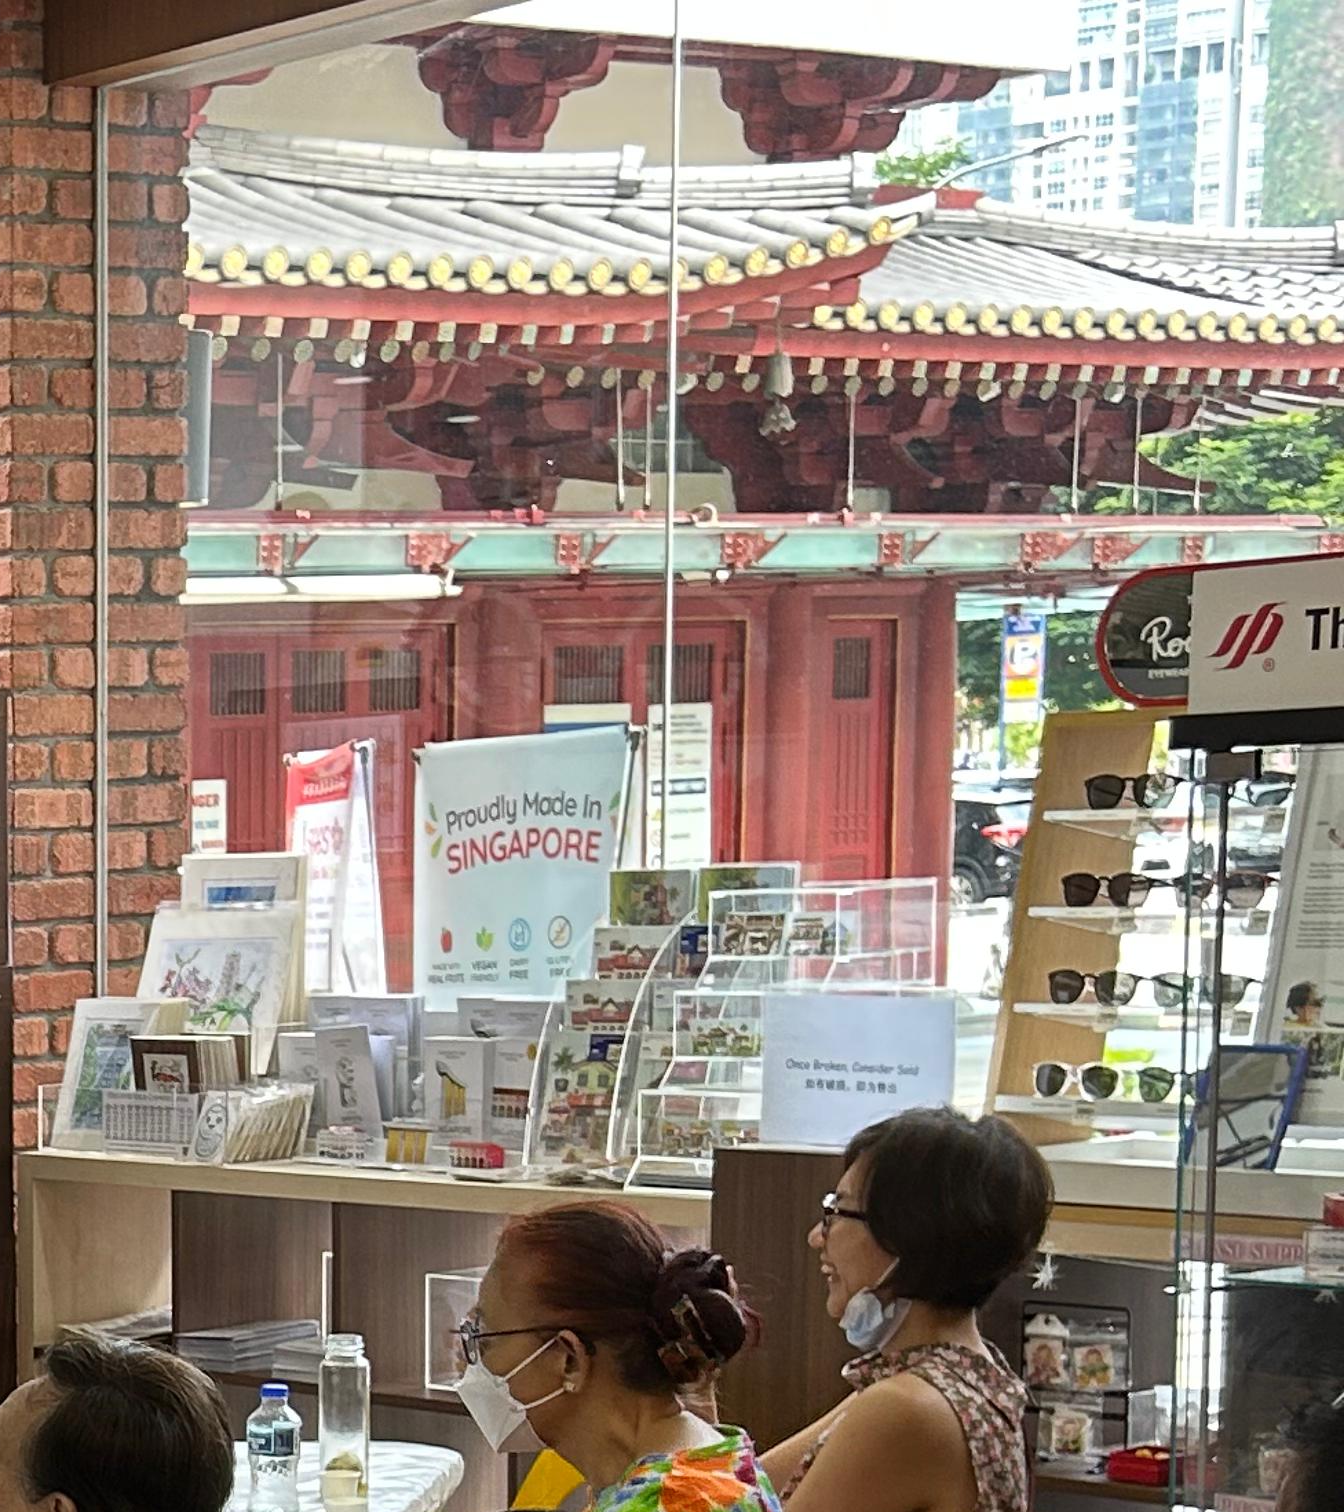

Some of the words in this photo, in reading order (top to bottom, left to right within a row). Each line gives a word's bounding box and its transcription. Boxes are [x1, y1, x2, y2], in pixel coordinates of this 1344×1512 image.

[445, 794, 517, 835] Proudly
[522, 790, 578, 818] Made
[581, 793, 603, 820] In
[447, 827, 601, 875] SINGAPORE
